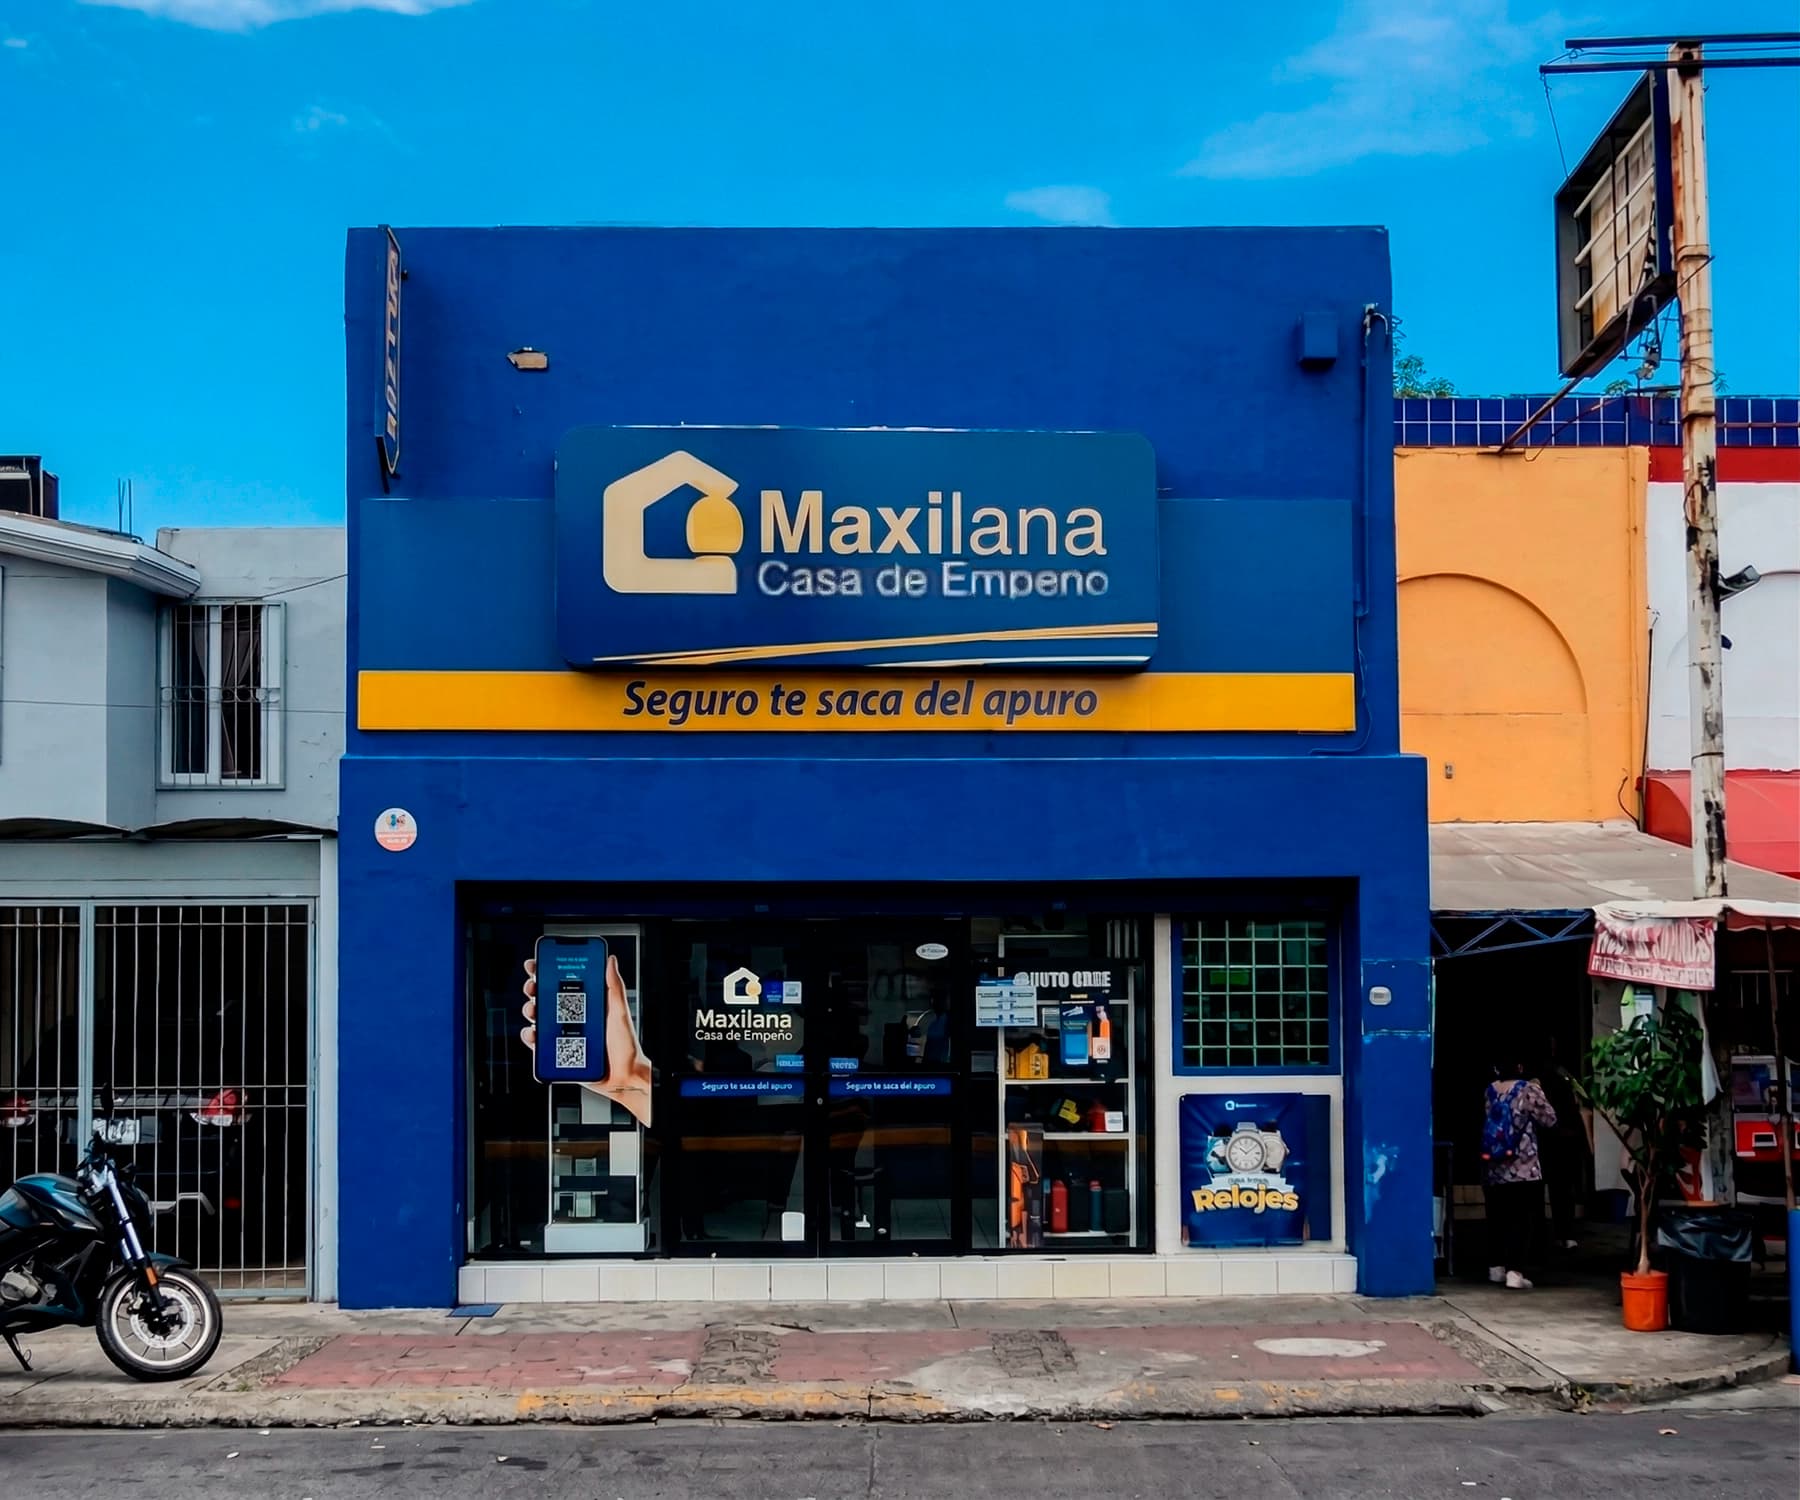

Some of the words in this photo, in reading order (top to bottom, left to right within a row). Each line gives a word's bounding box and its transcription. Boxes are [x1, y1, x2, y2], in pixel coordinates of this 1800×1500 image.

[760, 490, 1108, 555] Maxilana
[758, 561, 863, 597] Casa
[875, 562, 928, 597] de
[622, 680, 761, 725] Seguro
[769, 684, 806, 716] te
[815, 689, 903, 717] saca
[913, 680, 975, 717] del
[982, 689, 1099, 725] apuro
[695, 1008, 792, 1029] Maxilana
[695, 1029, 723, 1041] Casa
[725, 1029, 742, 1041] de
[743, 1029, 793, 1044] Empeño
[702, 1081, 729, 1092] Seguro
[730, 1082, 738, 1090] te
[756, 1081, 769, 1090] del
[846, 1081, 873, 1092] Seguro
[873, 1082, 882, 1090] te
[900, 1081, 912, 1090] del
[1191, 1183, 1299, 1214] Relojes
